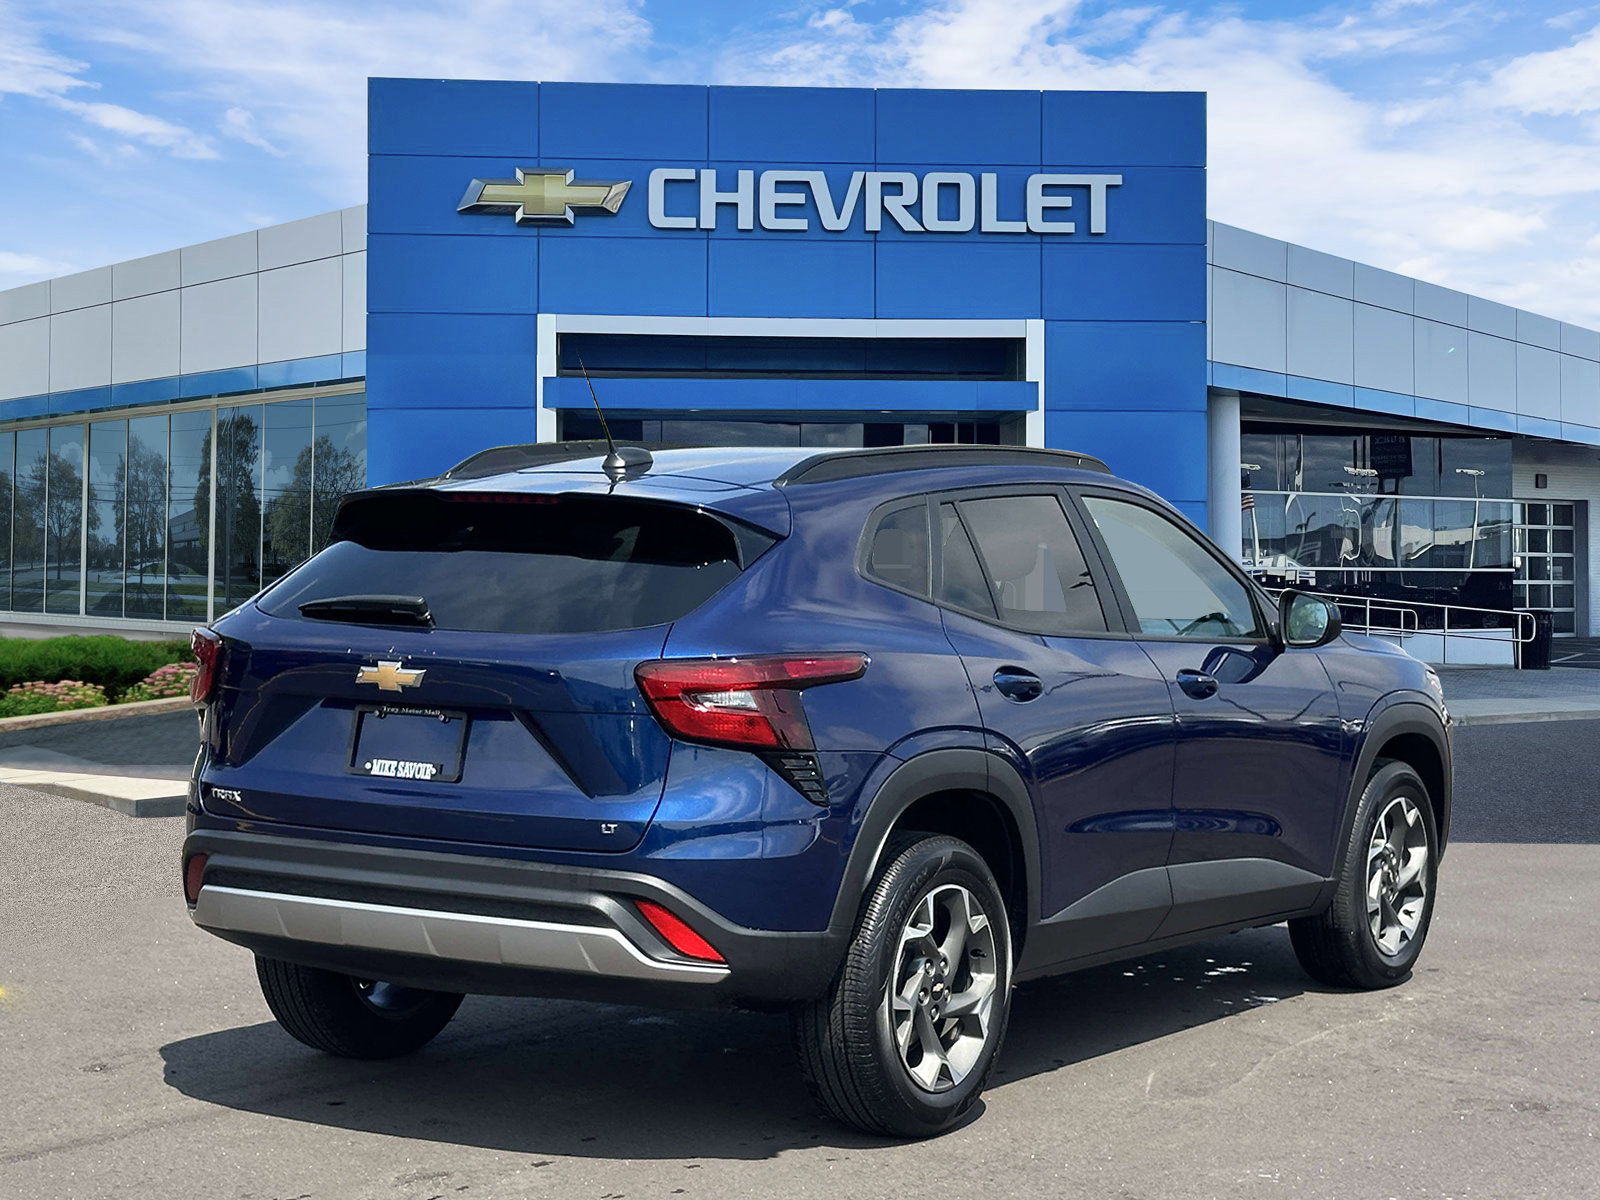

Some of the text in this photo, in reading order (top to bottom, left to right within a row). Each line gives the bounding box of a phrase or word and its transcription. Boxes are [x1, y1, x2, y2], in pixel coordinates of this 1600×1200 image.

[648, 168, 1123, 235] CHEVROLET
[382, 705, 399, 713] Troy
[370, 758, 398, 777] MIKE
[211, 787, 242, 802] TRAX
[601, 823, 618, 834] LT
